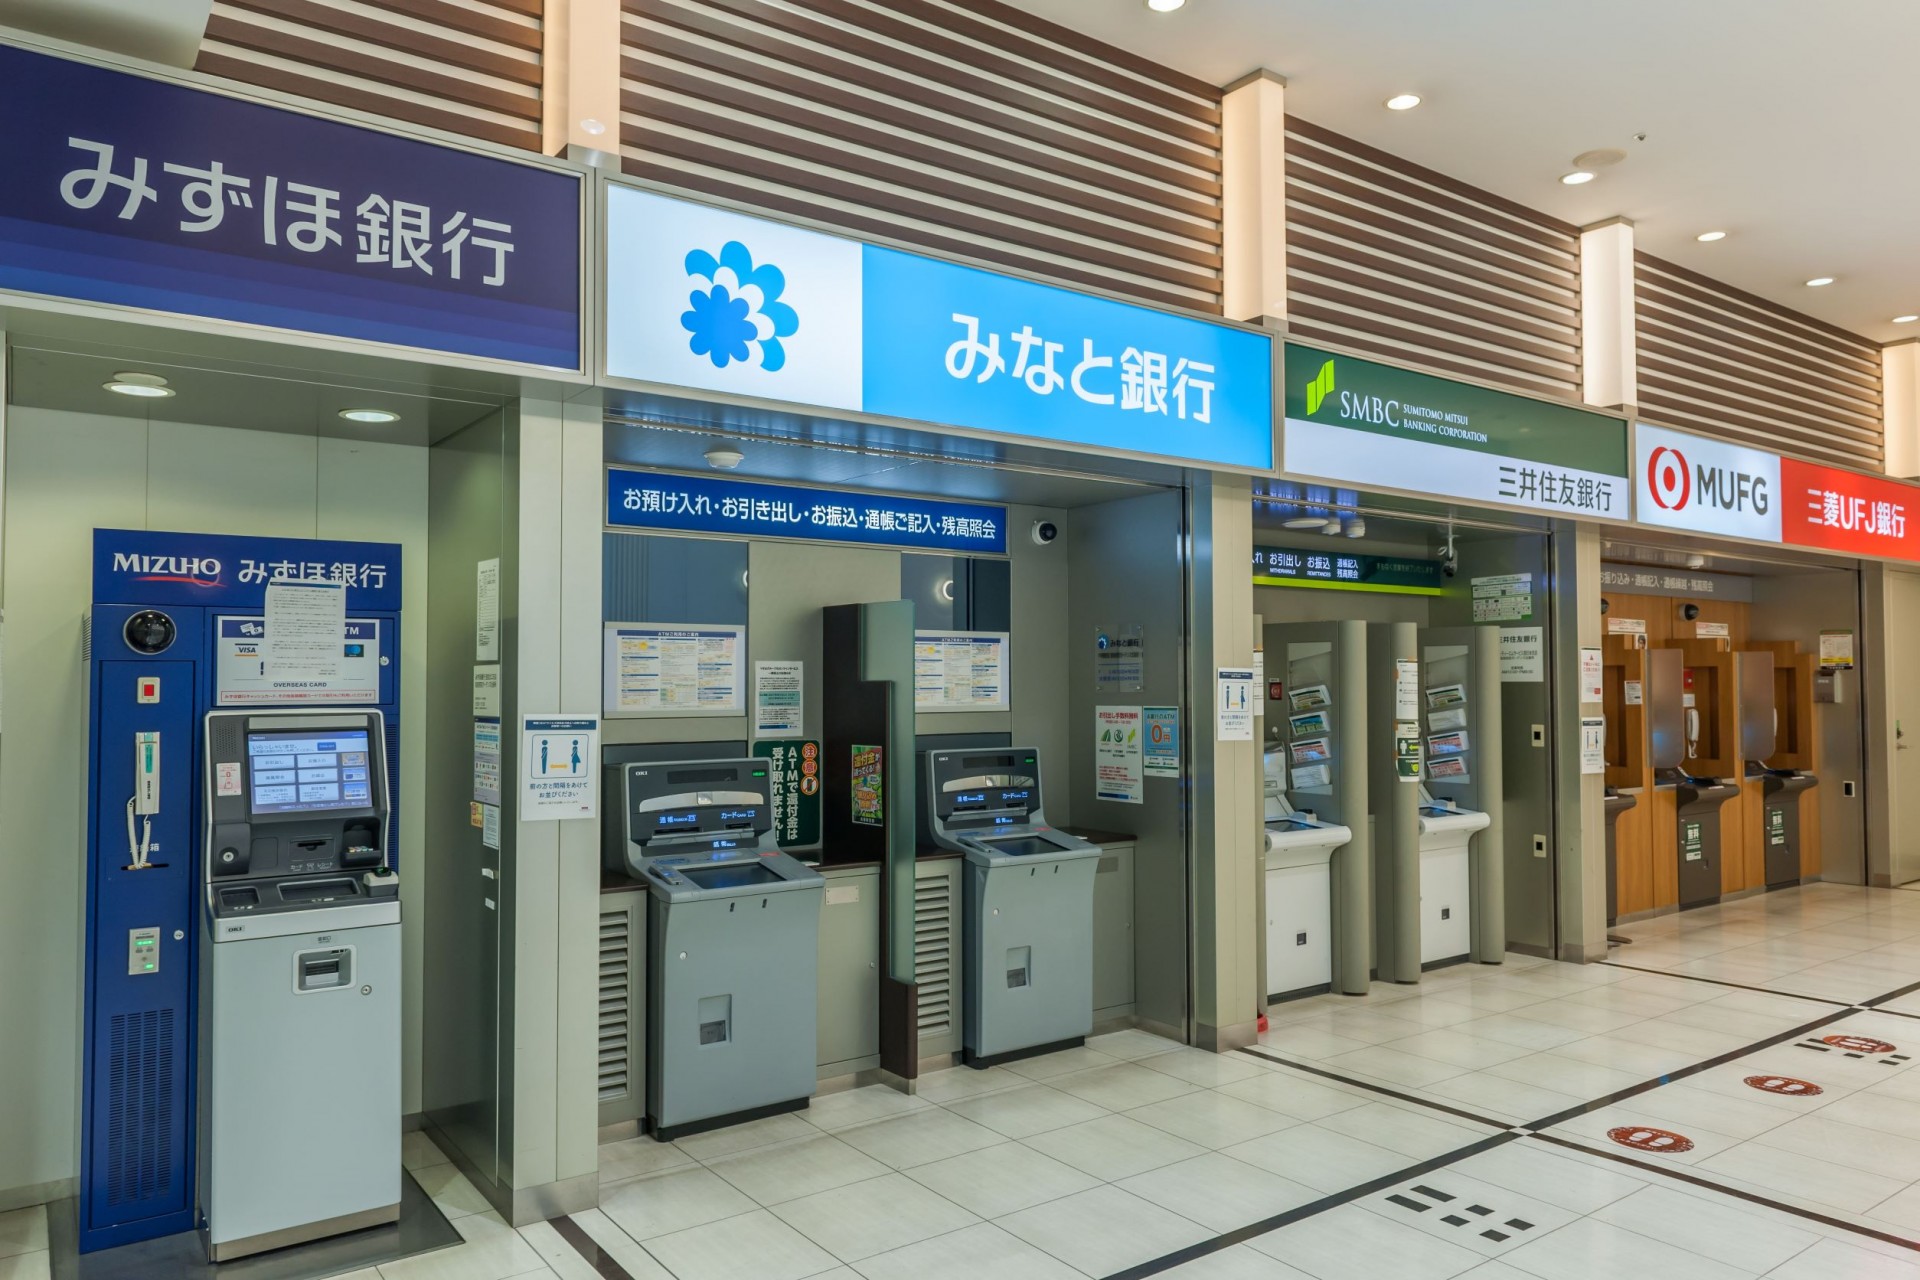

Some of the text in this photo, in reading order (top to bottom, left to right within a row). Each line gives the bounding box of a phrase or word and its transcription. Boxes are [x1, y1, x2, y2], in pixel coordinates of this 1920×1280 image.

[59, 136, 515, 287] みずほ銀行
[945, 312, 1215, 423] みなと銀行
[1340, 391, 1399, 427] SMBC
[1403, 404, 1468, 425] SUMITOMO MITSUI
[1403, 419, 1487, 443] BANKING CORPORATION
[1499, 466, 1612, 512] 三井住友銀行
[1697, 464, 1768, 515] MUFG
[1807, 488, 1905, 538] 三菱UFJ銀行
[113, 552, 221, 575] MIZUHO
[1270, 553, 1301, 567] お引出し
[1307, 556, 1331, 569] お振込
[238, 646, 256, 654] VISA
